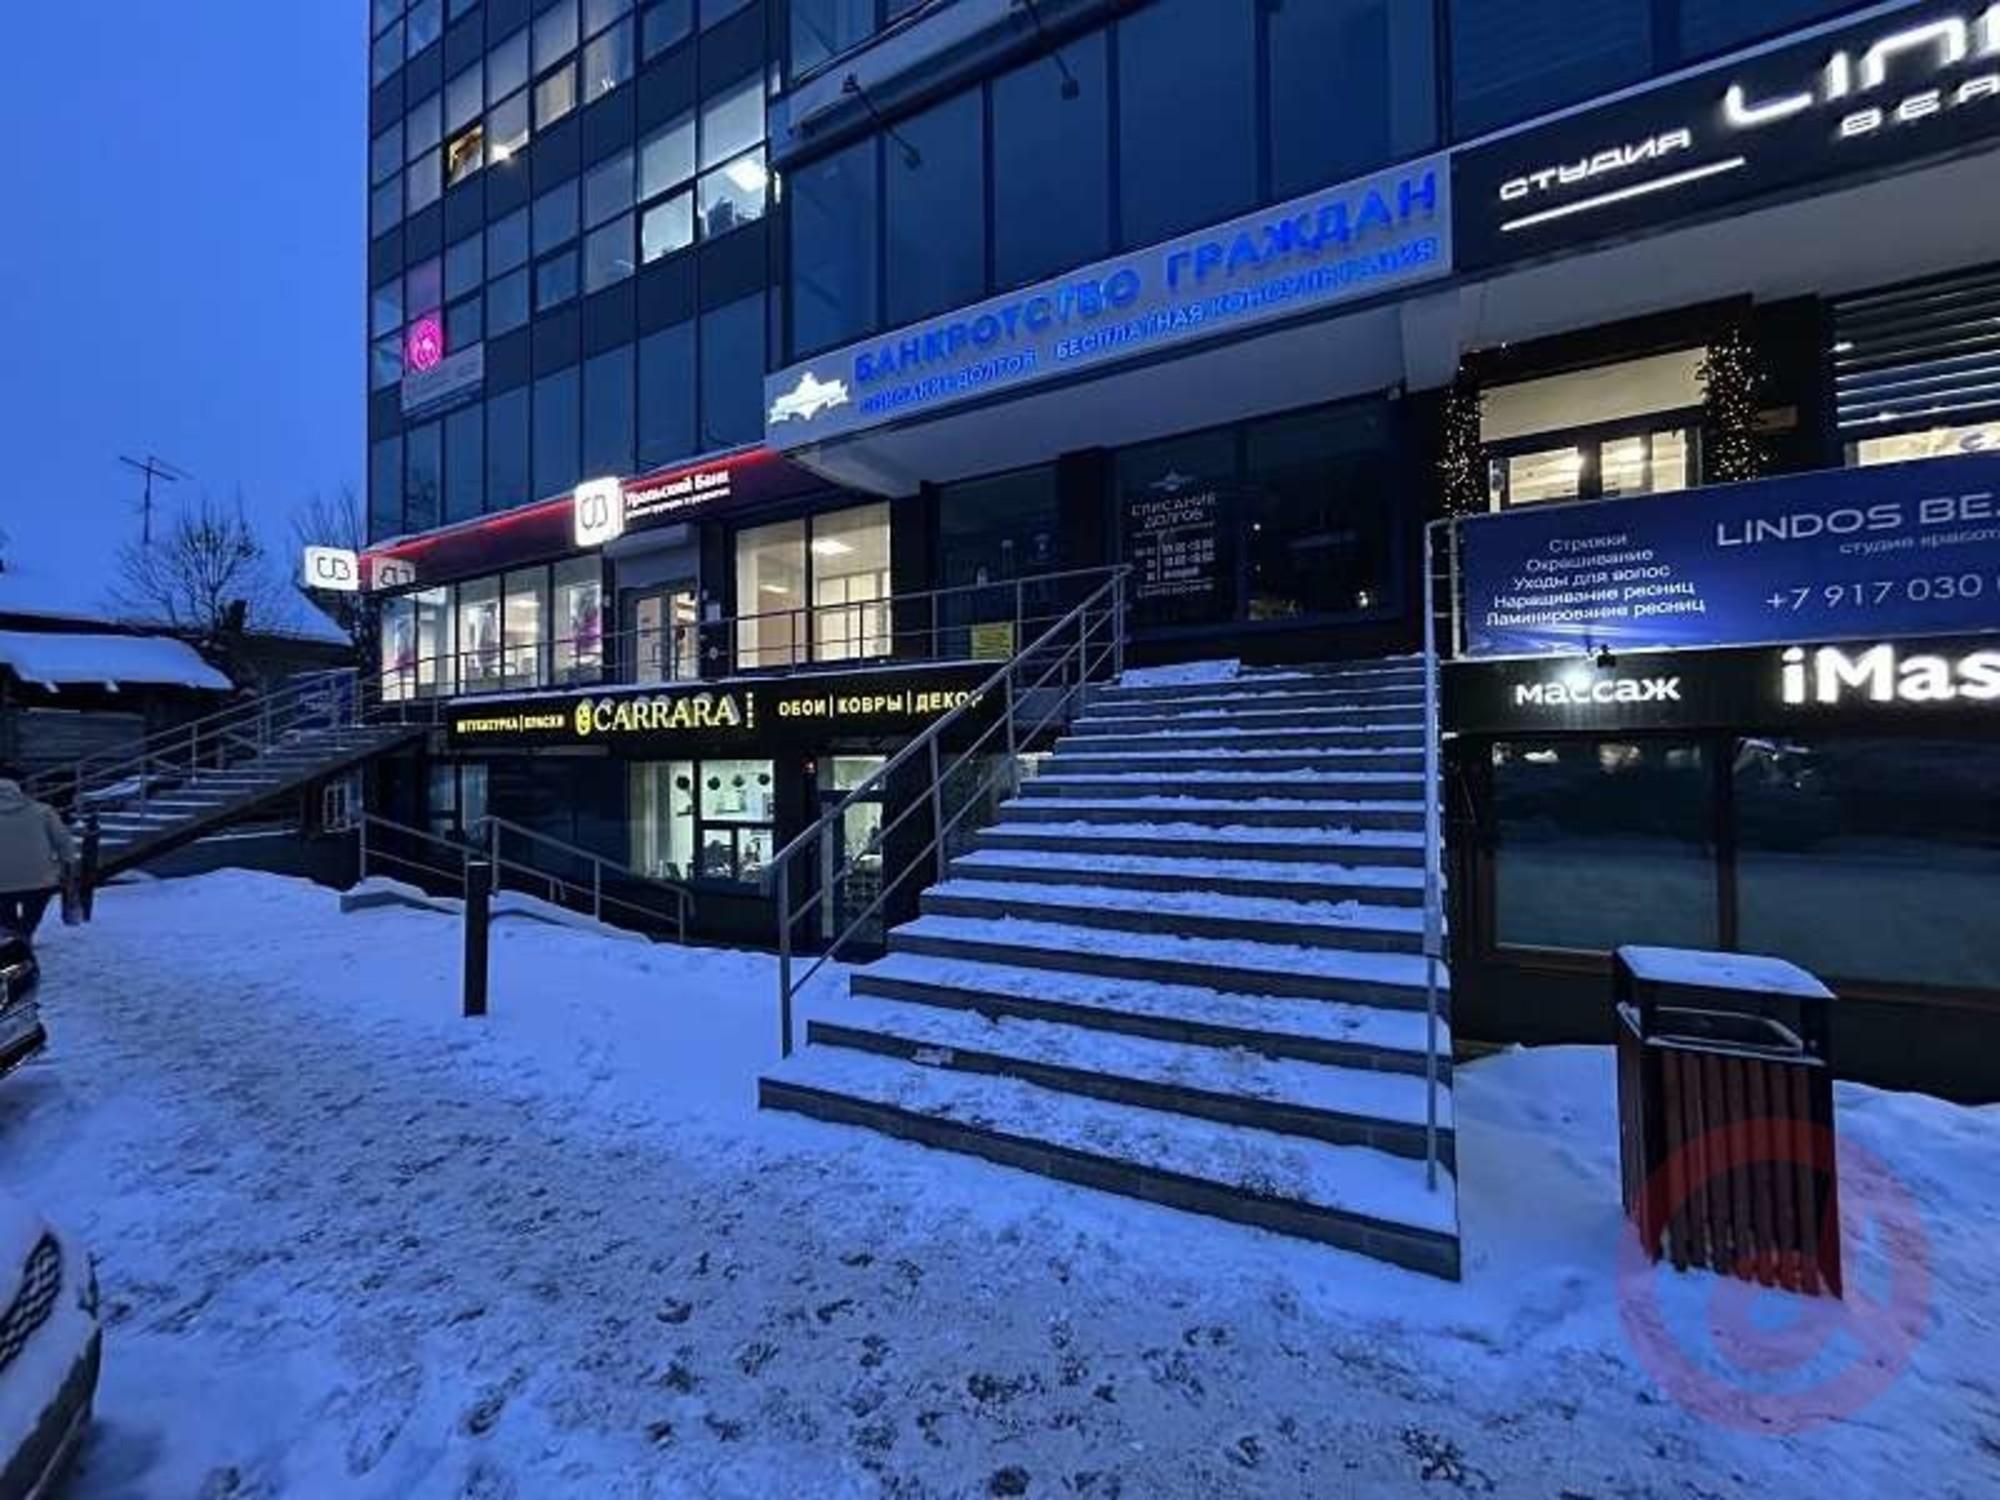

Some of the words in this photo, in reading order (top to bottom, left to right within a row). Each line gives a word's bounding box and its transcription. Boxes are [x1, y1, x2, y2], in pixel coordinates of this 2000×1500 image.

[1500, 129, 1691, 200] СТУДИЯ
[855, 268, 1141, 382] БАНКРОТСТВО
[1166, 171, 1437, 288] ГРАЖДАН
[1056, 301, 1204, 358] БЕСПЛАТНАЯ
[1717, 503, 1903, 546] LINDOS
[1919, 492, 2000, 523] BE
[1526, 549, 1654, 573] Окрашивание
[1572, 570, 1609, 587] для
[1612, 563, 1671, 582] волос
[1494, 588, 1619, 609] Наращивание
[1623, 581, 1696, 602] ресниц
[1767, 586, 1811, 610] +7
[1823, 581, 1894, 608] 917
[1907, 573, 1983, 601] 030
[1486, 605, 1629, 627] Ламинирование
[1634, 598, 1707, 619] ресниц
[778, 700, 826, 717] ОБОИ
[837, 694, 901, 714] КОВРЫ
[1515, 676, 1682, 706] массаж
[594, 693, 738, 732] CARRARA
